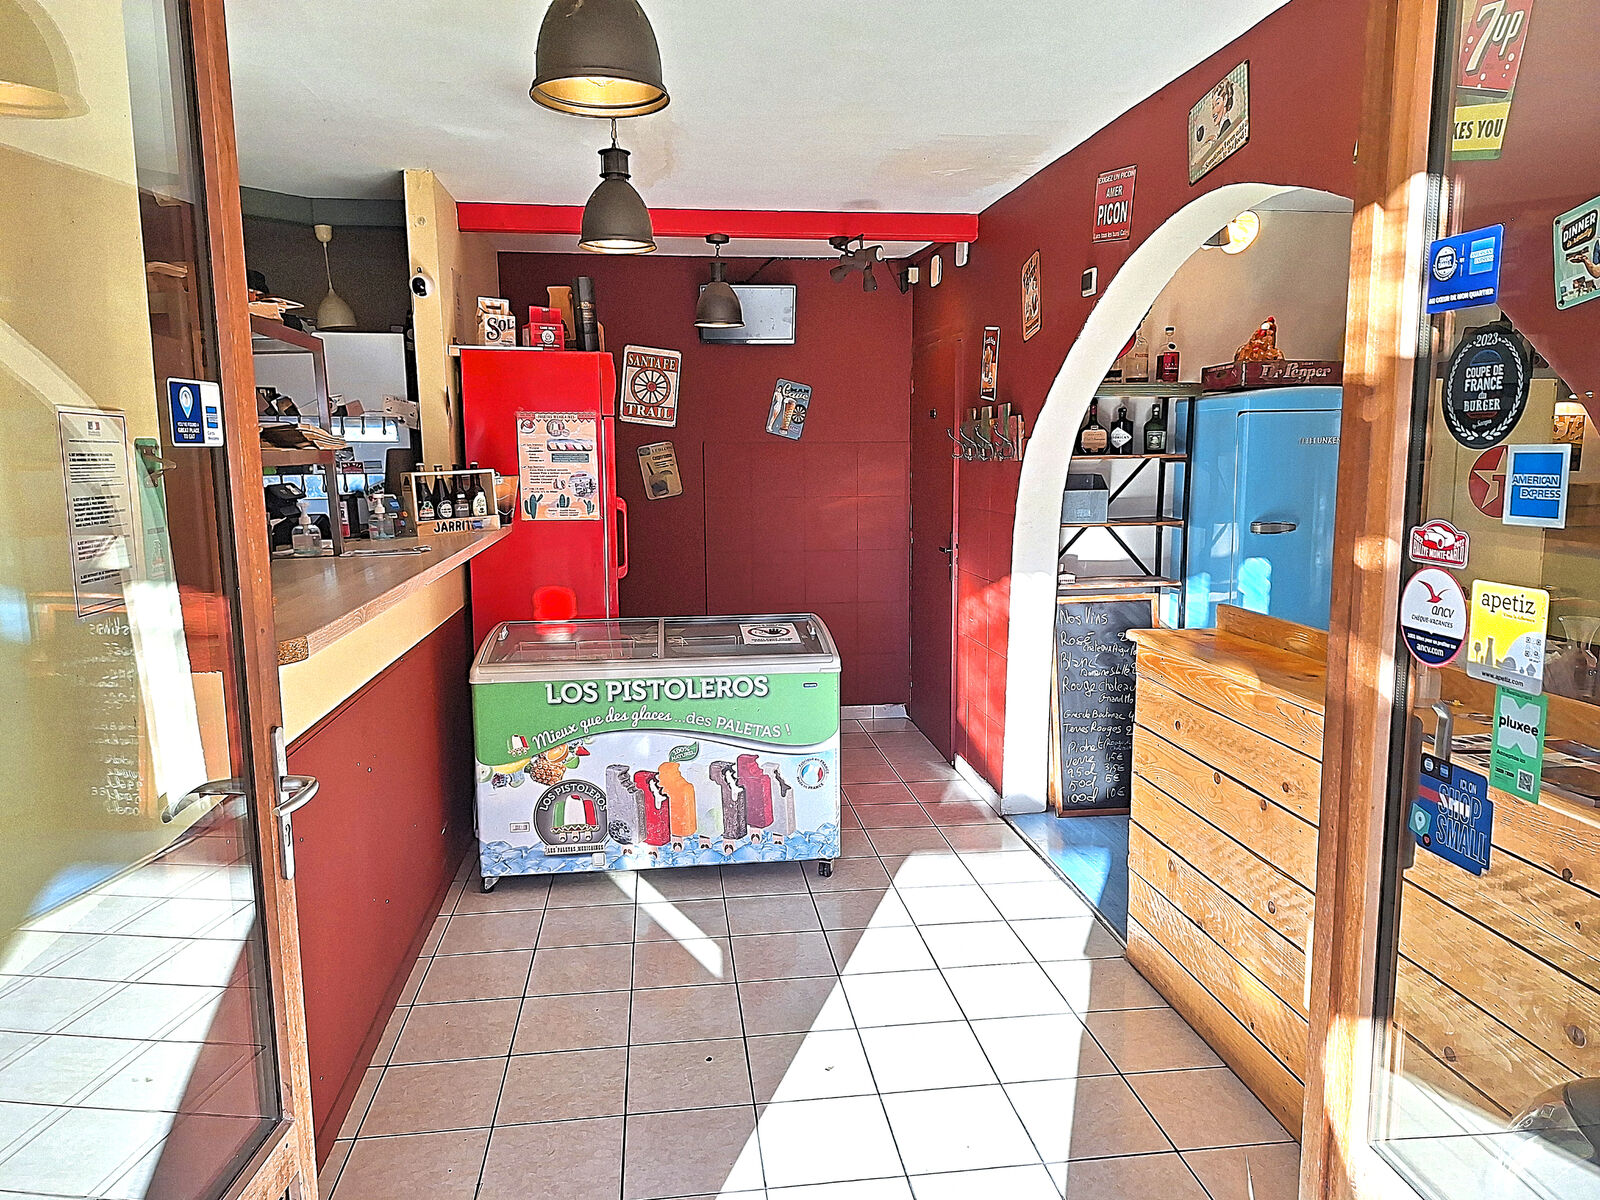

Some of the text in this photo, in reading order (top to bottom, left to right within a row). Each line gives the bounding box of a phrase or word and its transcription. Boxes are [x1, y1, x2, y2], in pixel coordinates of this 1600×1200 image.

[1465, 0, 1525, 75] 7up
[1477, 118, 1504, 140] YOU
[1120, 169, 1136, 179] PICON
[1106, 185, 1123, 198] AMER
[1097, 200, 1129, 226] PICON
[1563, 213, 1596, 243] DINNER
[1469, 288, 1494, 299] QUARTIER
[1475, 333, 1499, 347] 2023
[627, 353, 676, 370] SANTA FE
[1259, 362, 1331, 383] Dr Pepper
[1465, 364, 1505, 378] COUPE DE
[1464, 376, 1504, 392] FRANCE
[1477, 391, 1487, 399] du
[626, 403, 672, 419] TRAIL
[1463, 398, 1501, 412] BURGER
[1512, 475, 1559, 485] AMERICAN
[1521, 489, 1561, 498] EXPRESS
[433, 520, 475, 533] JARRIT
[1431, 605, 1455, 618] ancv
[1481, 593, 1536, 615] apetiz
[1060, 606, 1109, 626] Nos Vins
[1060, 630, 1096, 647] Rosé
[1416, 643, 1444, 657] ancv.com
[1060, 651, 1097, 671] Blanc
[1062, 675, 1097, 698] Rouge
[1481, 671, 1524, 688] www.apetiz.com
[544, 675, 769, 705] LOS PISTOLEROS
[532, 723, 579, 750] Mieux
[580, 715, 605, 733] que
[605, 706, 629, 723] des
[631, 704, 673, 728] glaces
[716, 716, 781, 738] PALETAS
[1498, 715, 1539, 737] pluxee
[540, 783, 608, 811] LOS PISTOLEROS
[1106, 786, 1126, 799] 10€
[1437, 783, 1482, 828] SHOP
[1436, 813, 1487, 866] SMALL
